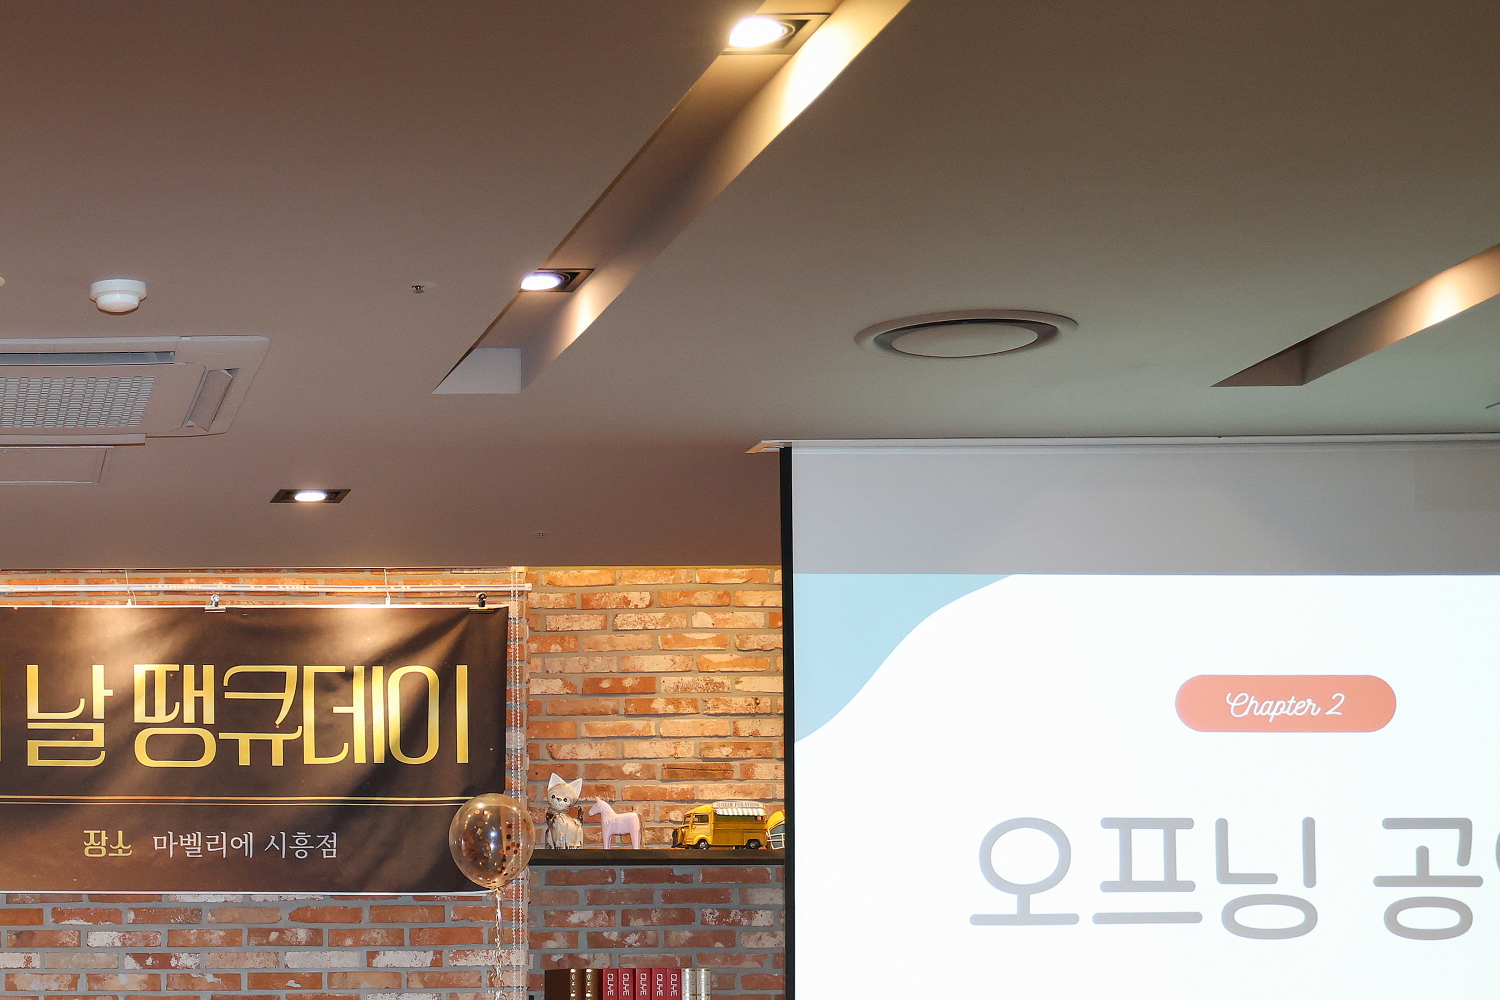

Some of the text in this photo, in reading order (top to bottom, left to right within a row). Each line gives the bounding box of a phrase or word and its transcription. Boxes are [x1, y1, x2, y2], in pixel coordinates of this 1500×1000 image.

[26, 663, 114, 767] 날
[133, 663, 469, 768] 땡큐데이
[1225, 691, 1346, 723] Chapter 2
[83, 829, 338, 859] 장소 마벨리에 시흥점
[969, 817, 1500, 940] 오프닝 공
